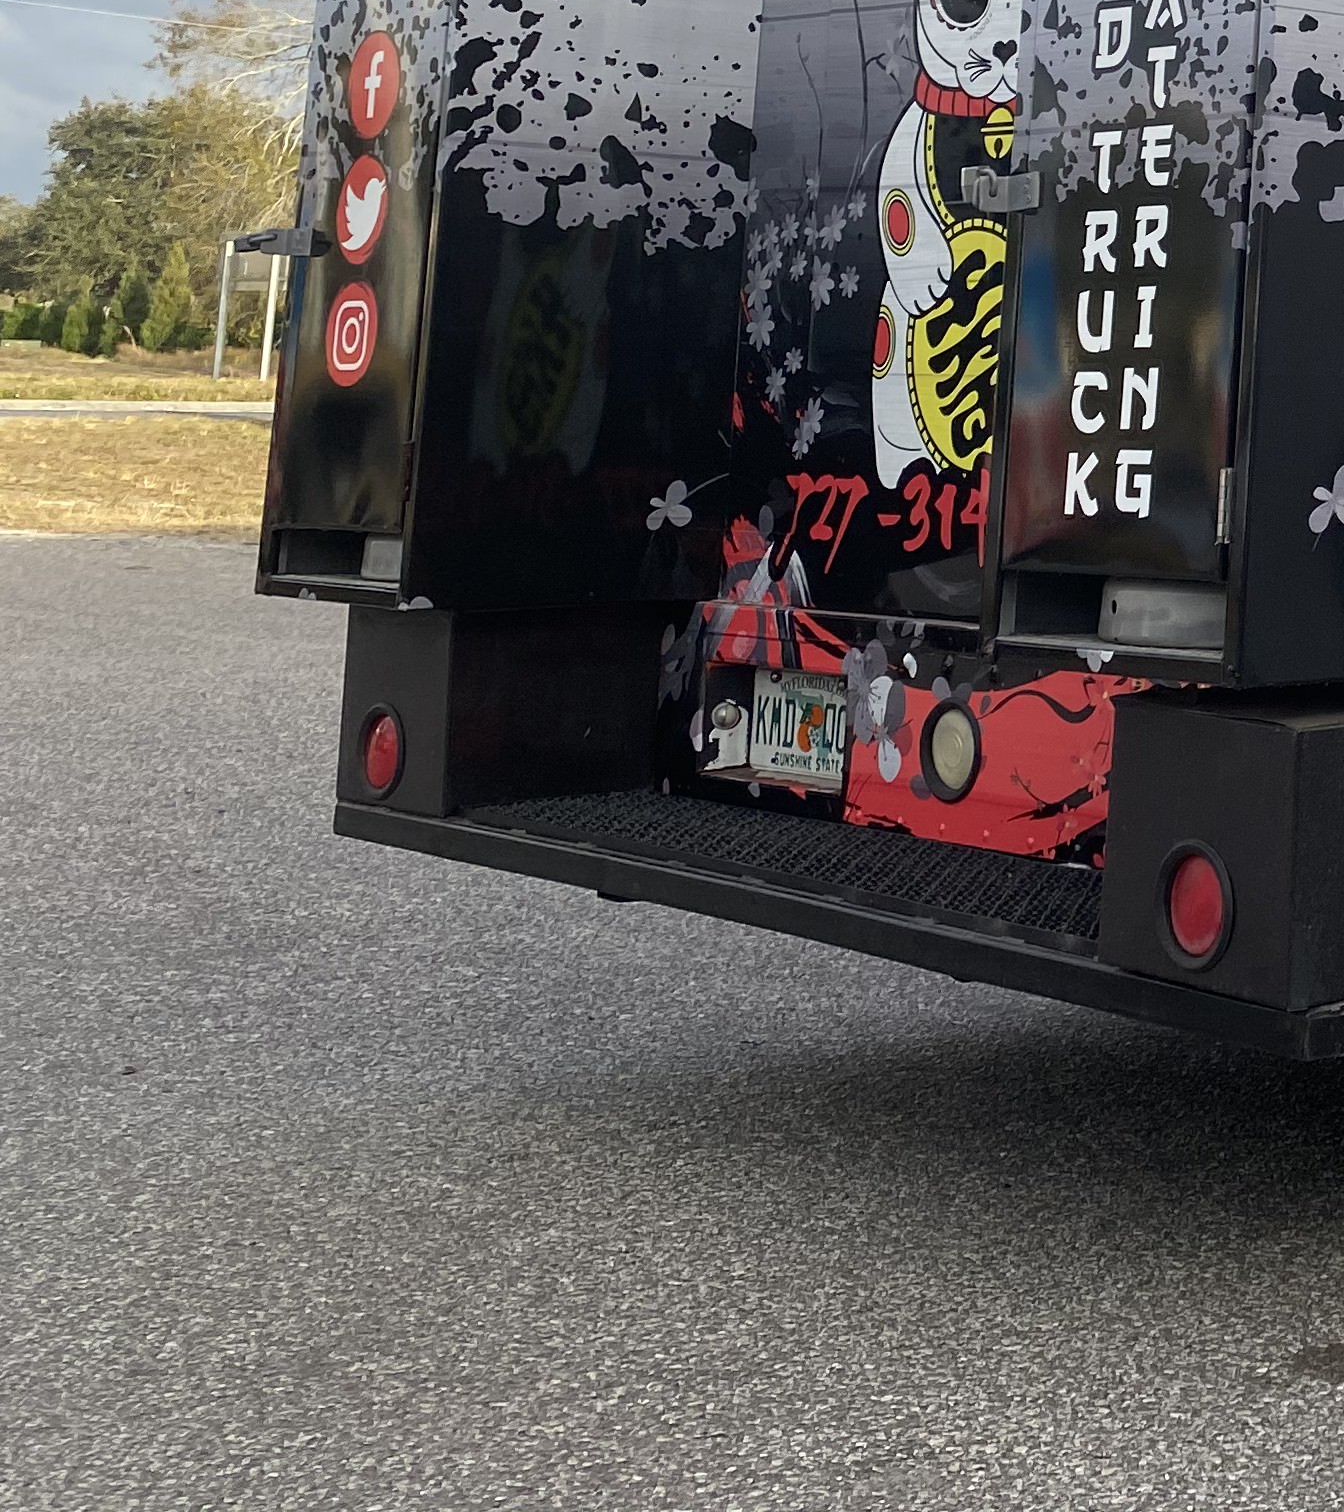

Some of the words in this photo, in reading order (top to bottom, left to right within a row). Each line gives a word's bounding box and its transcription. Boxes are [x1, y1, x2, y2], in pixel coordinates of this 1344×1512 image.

[1064, 130, 1122, 518] TRUCK
[774, 751, 812, 771] SUNSHINE
[815, 758, 841, 774] STATE
